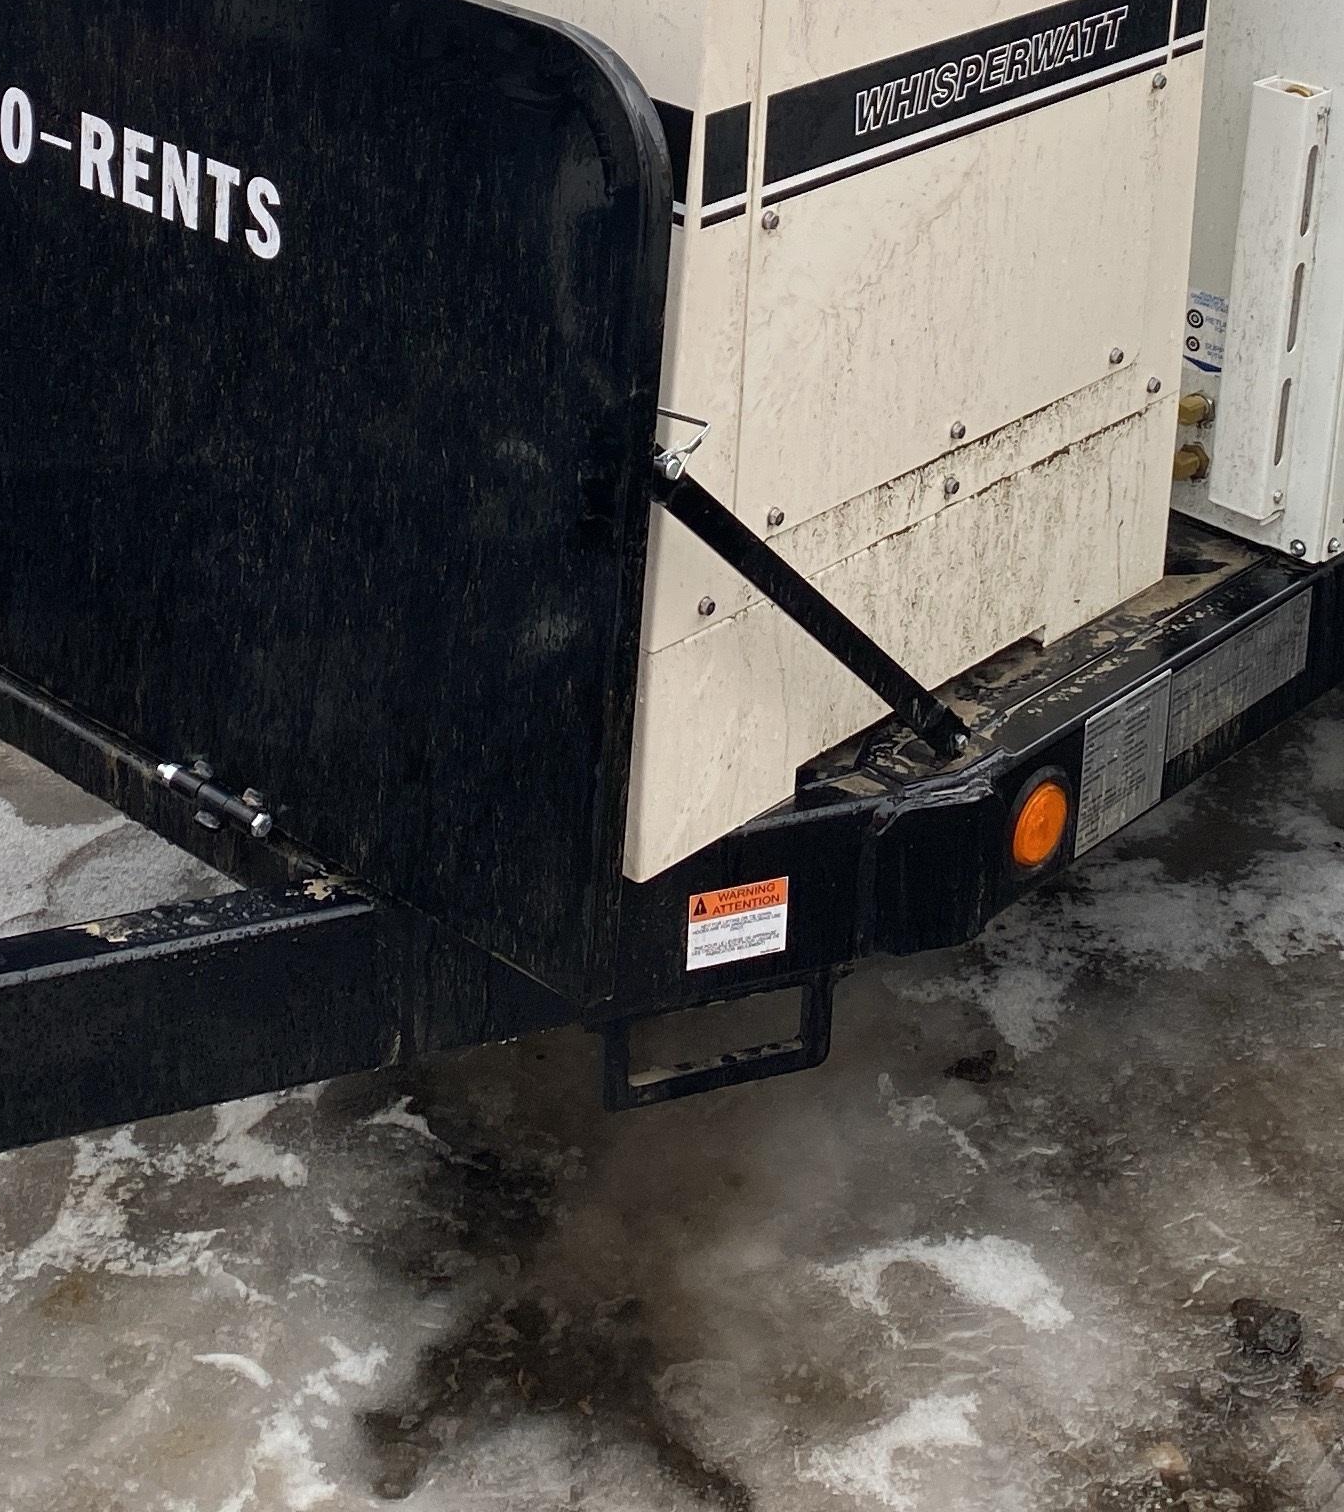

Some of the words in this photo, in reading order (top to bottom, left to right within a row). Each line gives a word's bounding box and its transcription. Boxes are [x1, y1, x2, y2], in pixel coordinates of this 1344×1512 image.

[855, 5, 1129, 136] WHISPERWATT
[717, 882, 775, 902] WARNING
[713, 894, 780, 915] ATTENTION
